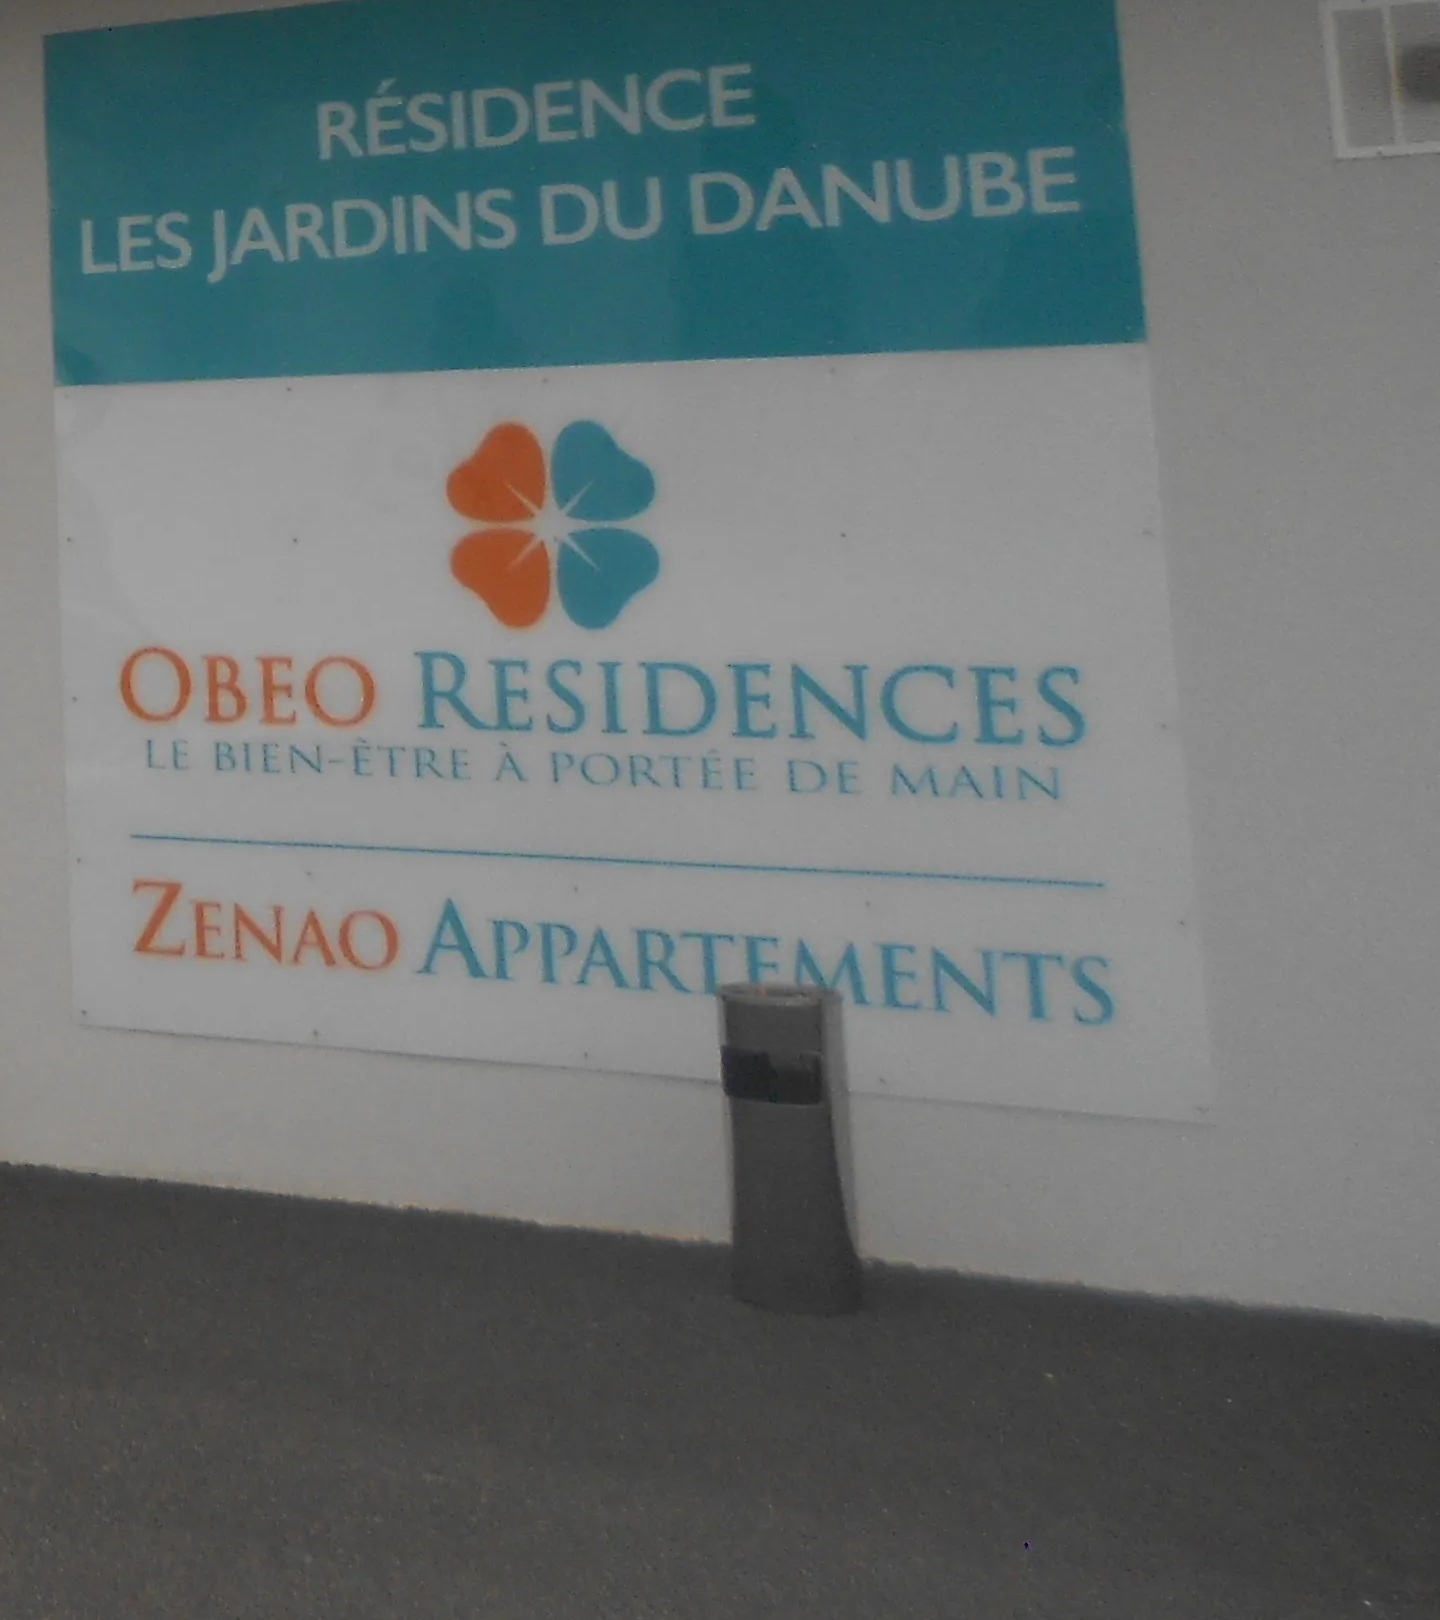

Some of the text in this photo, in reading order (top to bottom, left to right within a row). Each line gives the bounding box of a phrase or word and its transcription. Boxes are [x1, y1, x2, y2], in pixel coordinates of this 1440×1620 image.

[317, 64, 755, 160] RÉSIDENCE
[81, 147, 1081, 283] LES JARDINS DU DANUBE
[120, 646, 1087, 747] OBEO RESIDENCES
[145, 737, 1062, 801] LE BIEN-ÊTRE À PORTÉE DE MAIN
[133, 881, 1115, 1026] ZENAO APPARTEMENTS
